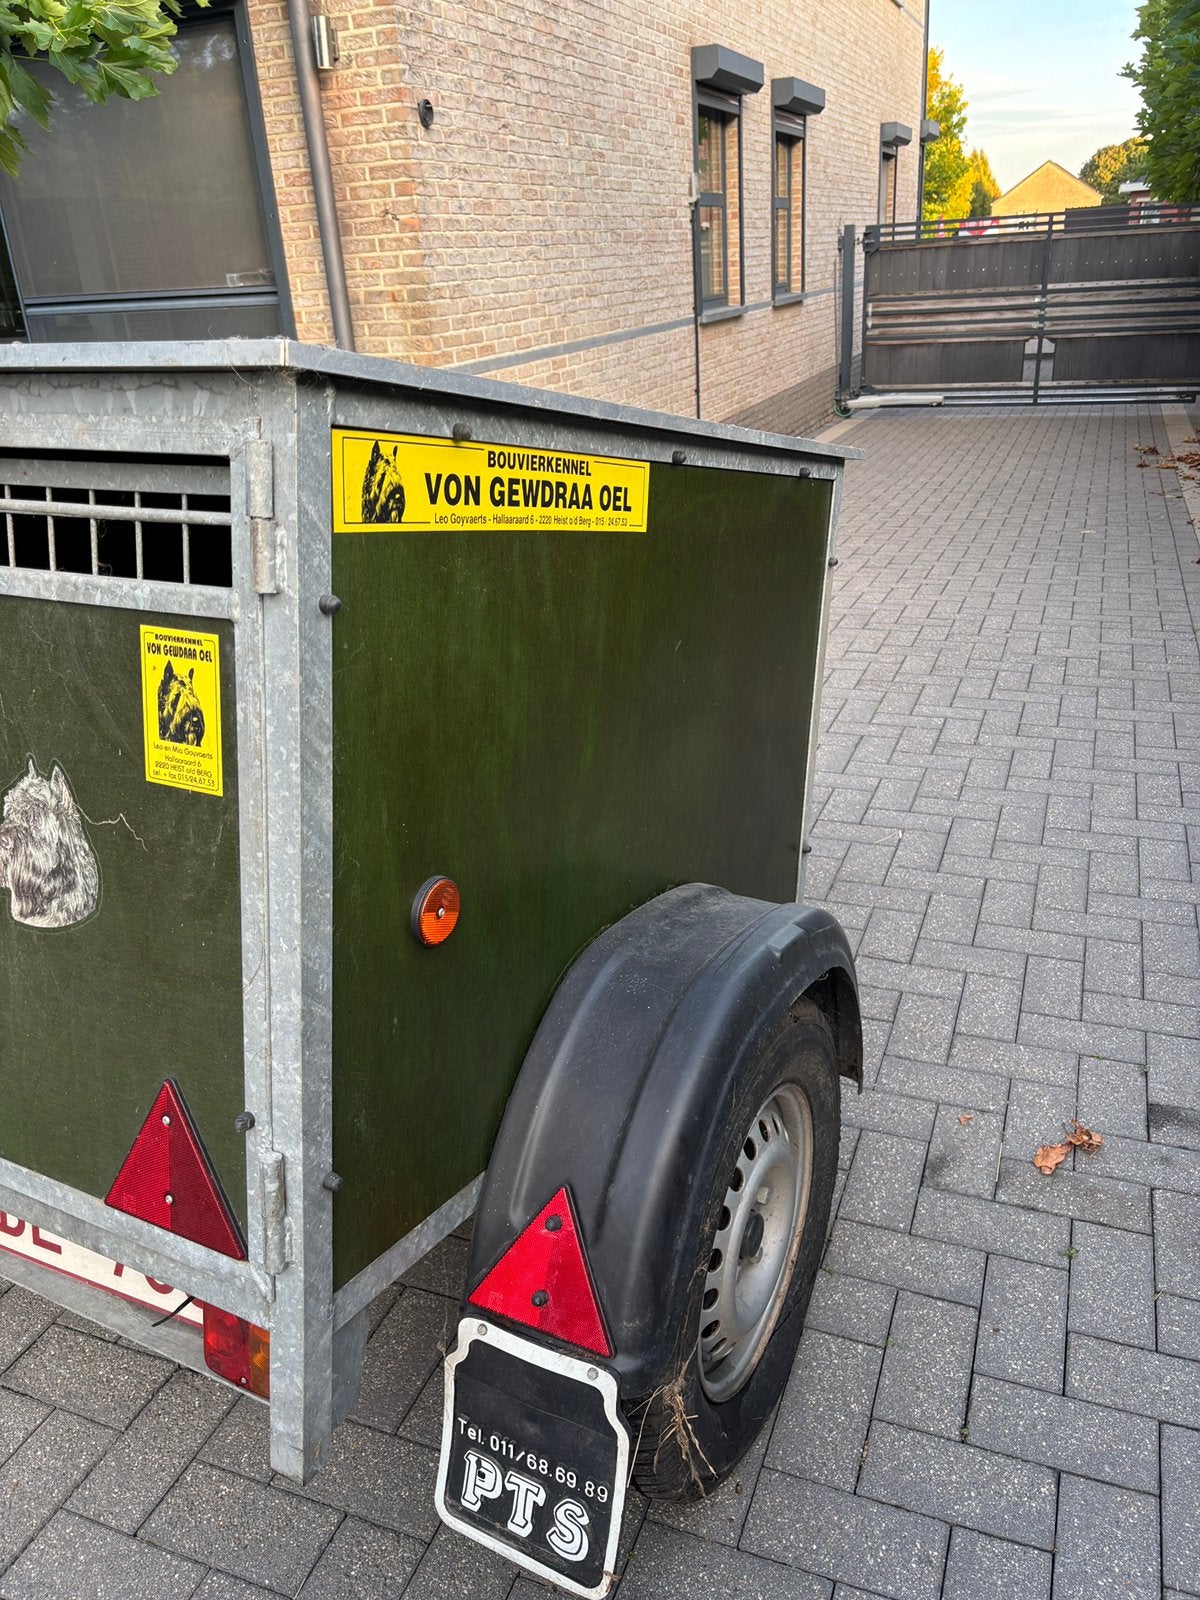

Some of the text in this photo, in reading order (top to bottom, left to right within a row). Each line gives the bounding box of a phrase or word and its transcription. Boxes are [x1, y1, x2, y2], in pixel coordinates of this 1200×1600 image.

[487, 450, 592, 477] BOUVIERKENNEL
[424, 472, 632, 512] VON GEWDRAA OEL
[434, 513, 448, 524] Leo
[450, 513, 487, 526] Goyvaerts
[492, 514, 529, 525] Hallaaraard
[530, 515, 535, 524] 6
[539, 515, 552, 525] 2220
[553, 515, 568, 525] Heist
[579, 516, 592, 528] Berg
[155, 633, 203, 647] BOUVIERKENNEL
[147, 642, 212, 663] VON GEWDRAA OEL
[153, 742, 163, 750] Leo
[172, 745, 183, 754] Mia
[155, 760, 169, 770] 2220
[170, 763, 184, 773] HEIST
[197, 768, 212, 778] BERG
[197, 760, 202, 768] 6
[458, 1417, 609, 1503] Tel. 011/68.69.89
[461, 1450, 590, 1562] PTS
